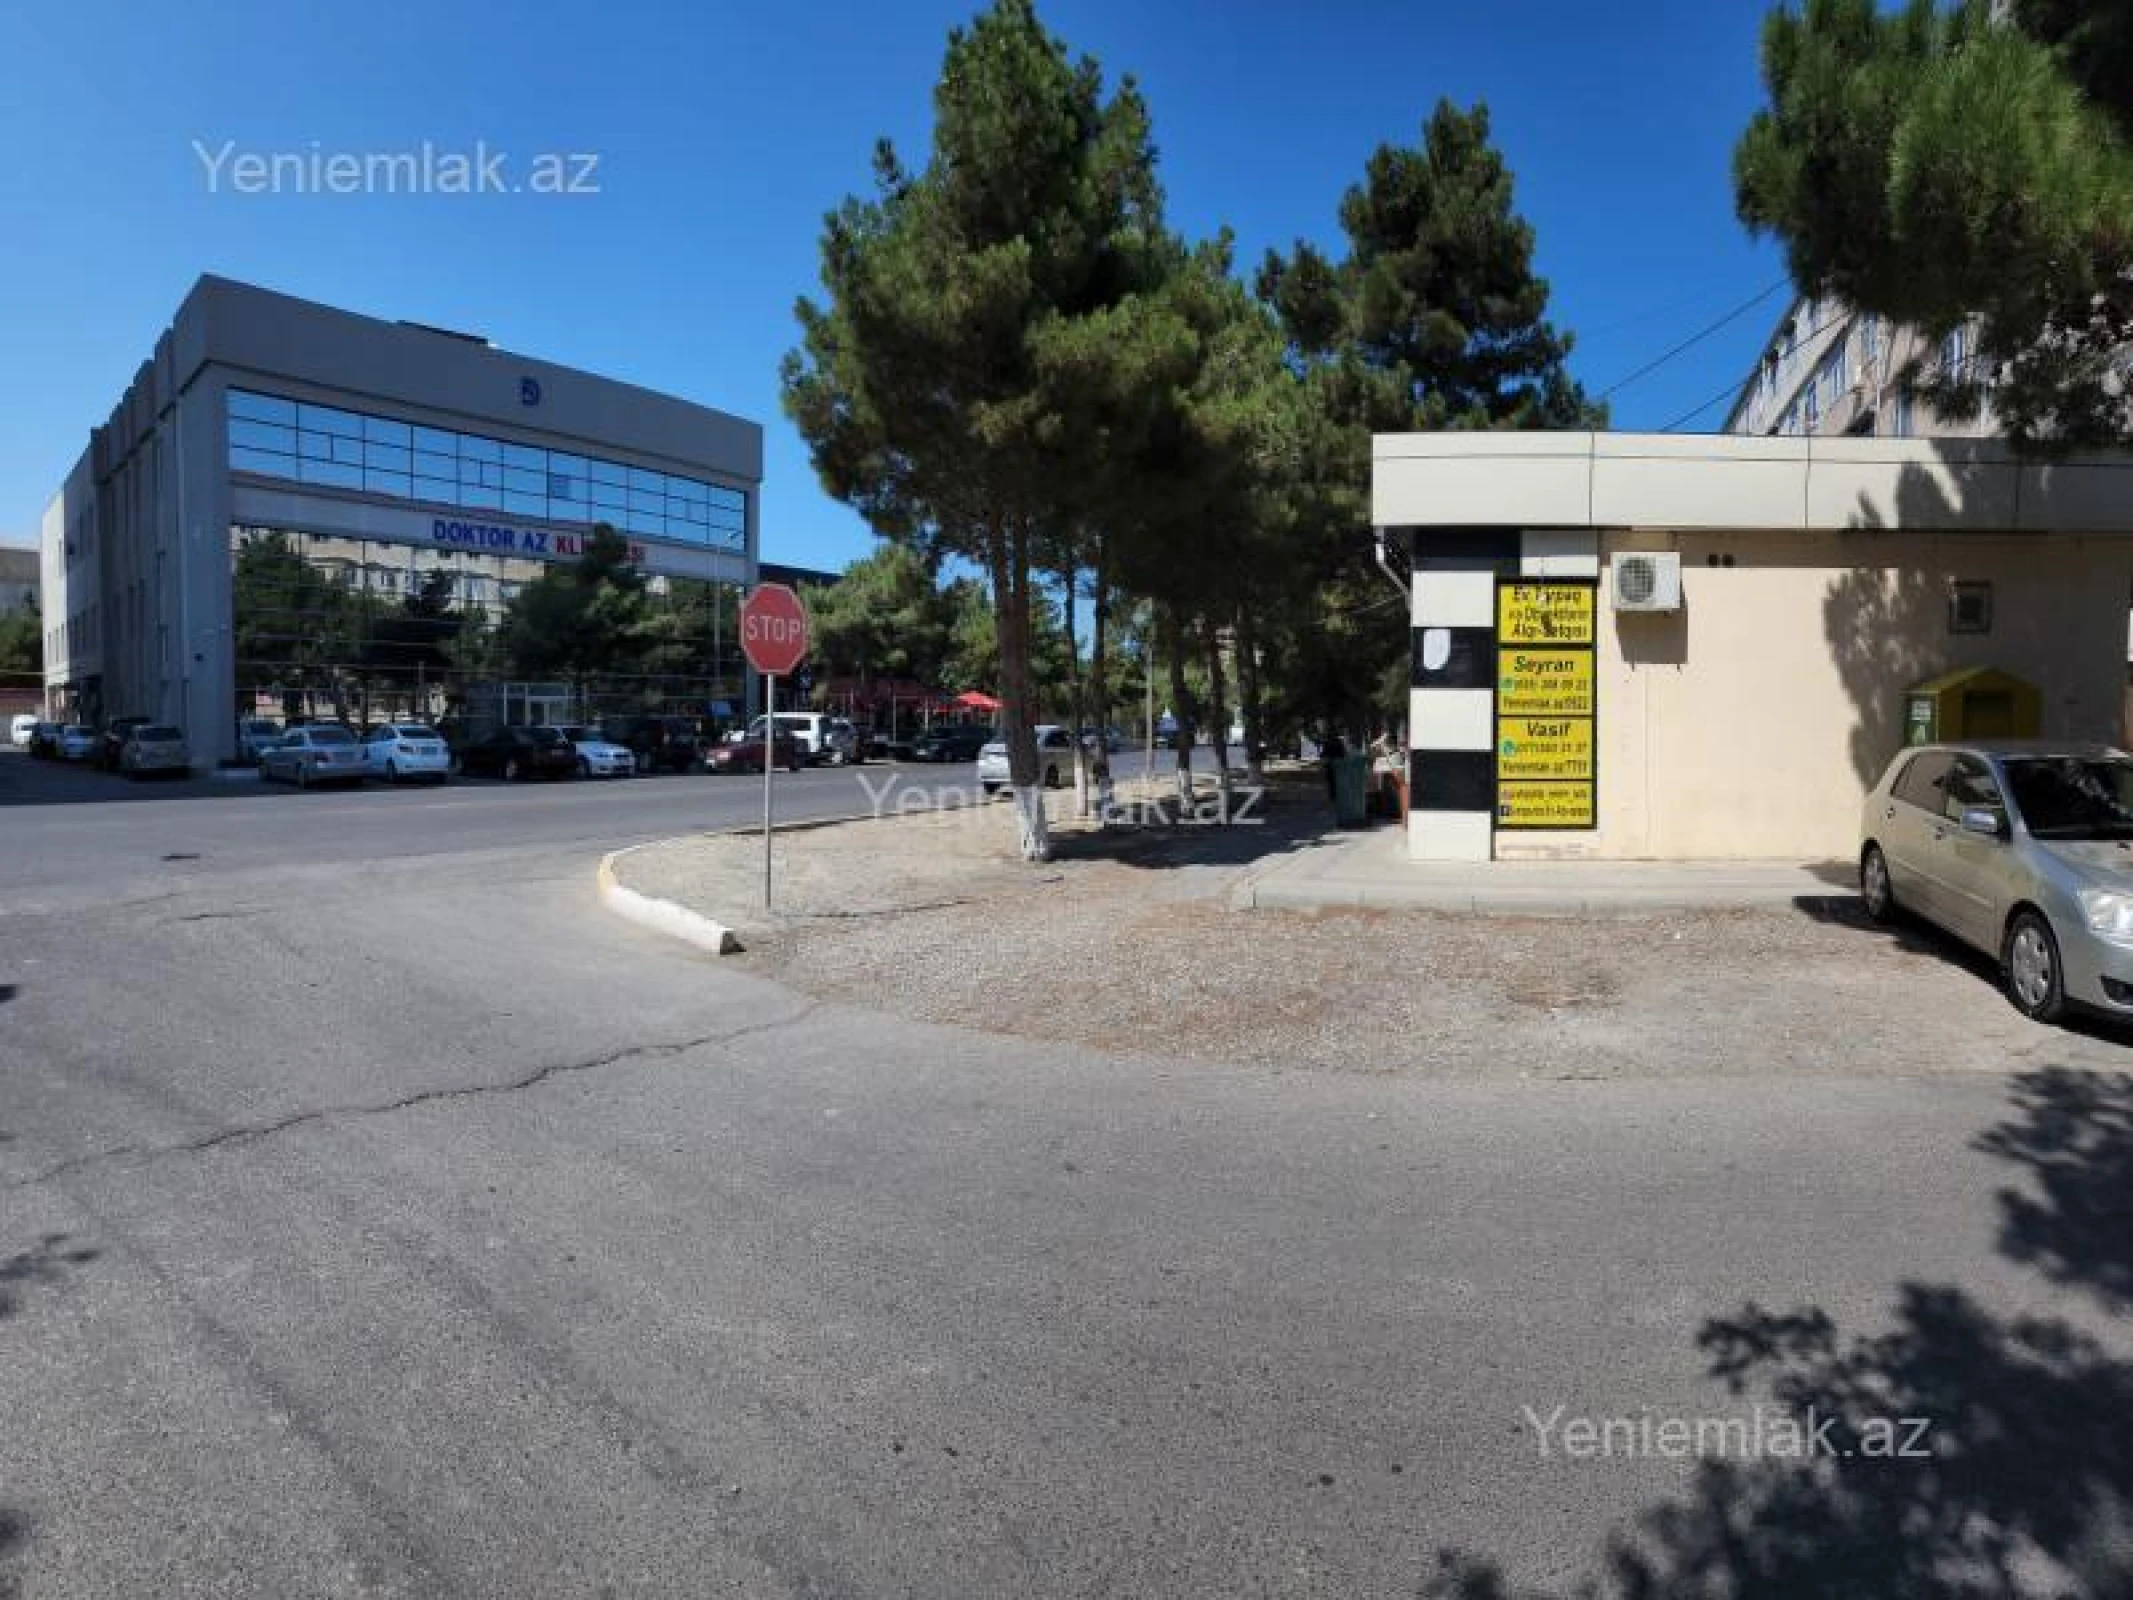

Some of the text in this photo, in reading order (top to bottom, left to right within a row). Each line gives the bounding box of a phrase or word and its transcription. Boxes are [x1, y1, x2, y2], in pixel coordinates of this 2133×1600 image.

[433, 519, 514, 548] DOKTOR
[522, 532, 547, 553] AZ
[746, 615, 801, 644] STOP
[1514, 655, 1574, 676] Seyran
[1527, 720, 1572, 737] Vasif
